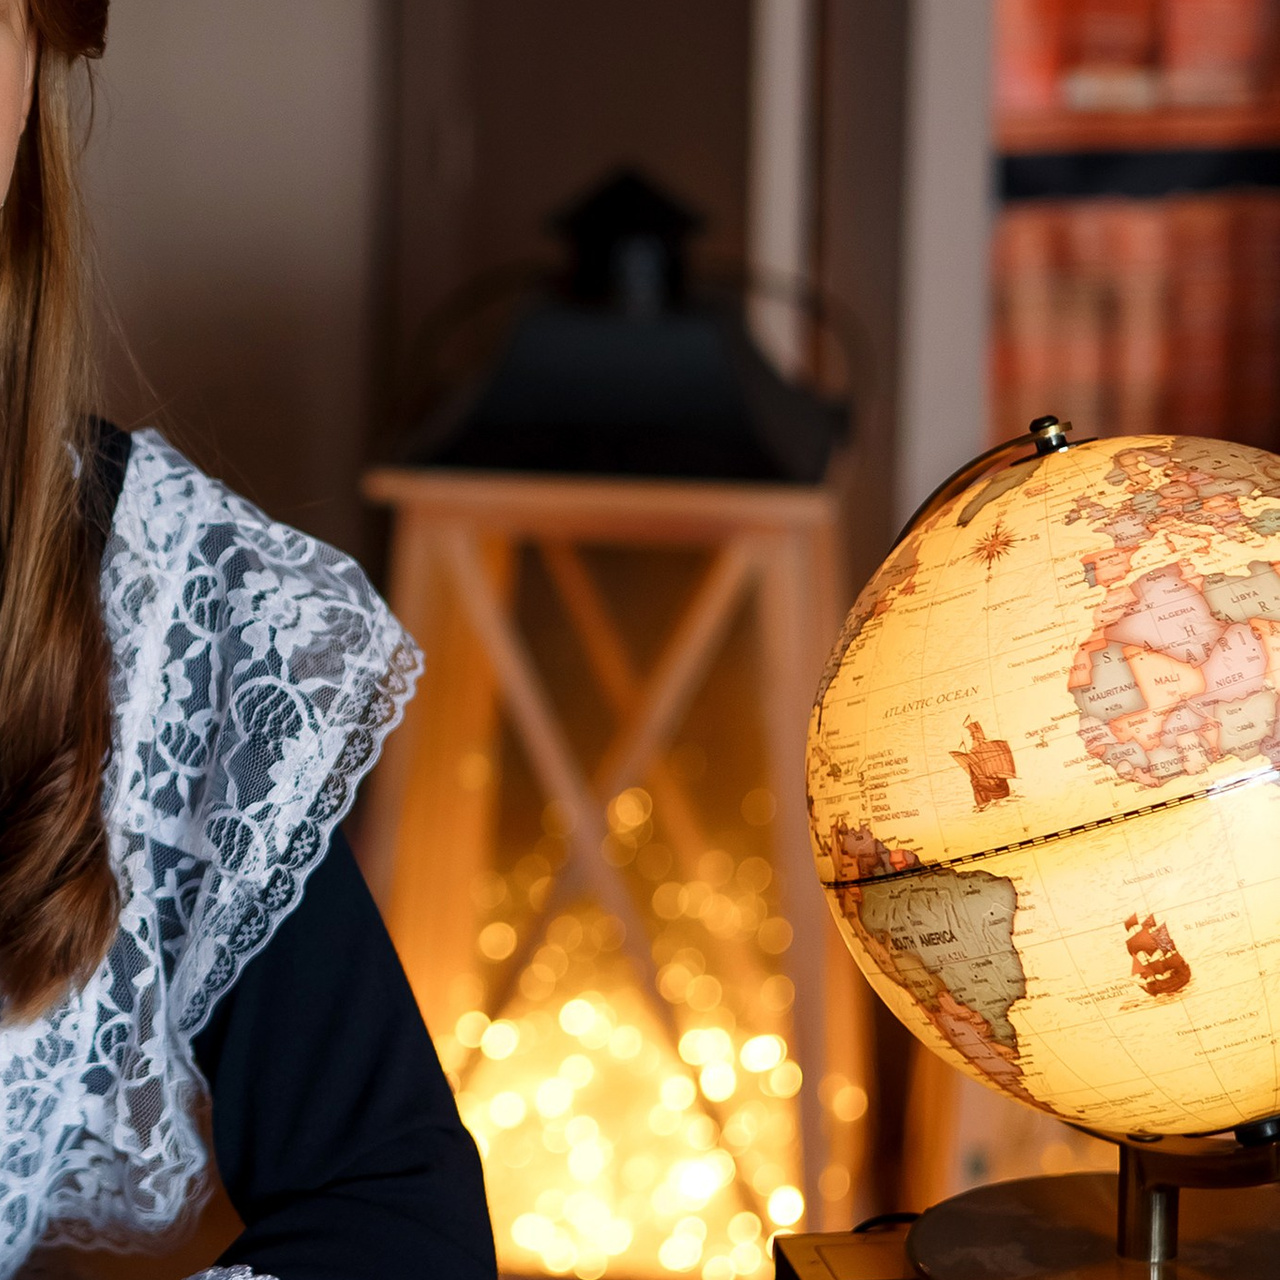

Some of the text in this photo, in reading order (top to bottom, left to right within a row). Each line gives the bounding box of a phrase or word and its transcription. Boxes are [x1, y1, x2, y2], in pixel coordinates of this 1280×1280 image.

[1230, 590, 1260, 604] LIBYA
[1157, 606, 1196, 622] ALGERIA
[1154, 673, 1181, 686] MALI
[1215, 672, 1245, 688] NIGER
[1088, 682, 1139, 703] MAURITANIA
[882, 685, 980, 720] ATLANTIC OCEAN
[1111, 748, 1138, 761] GUINEA
[891, 937, 918, 952] SOUTH
[920, 929, 958, 948] AMERICA
